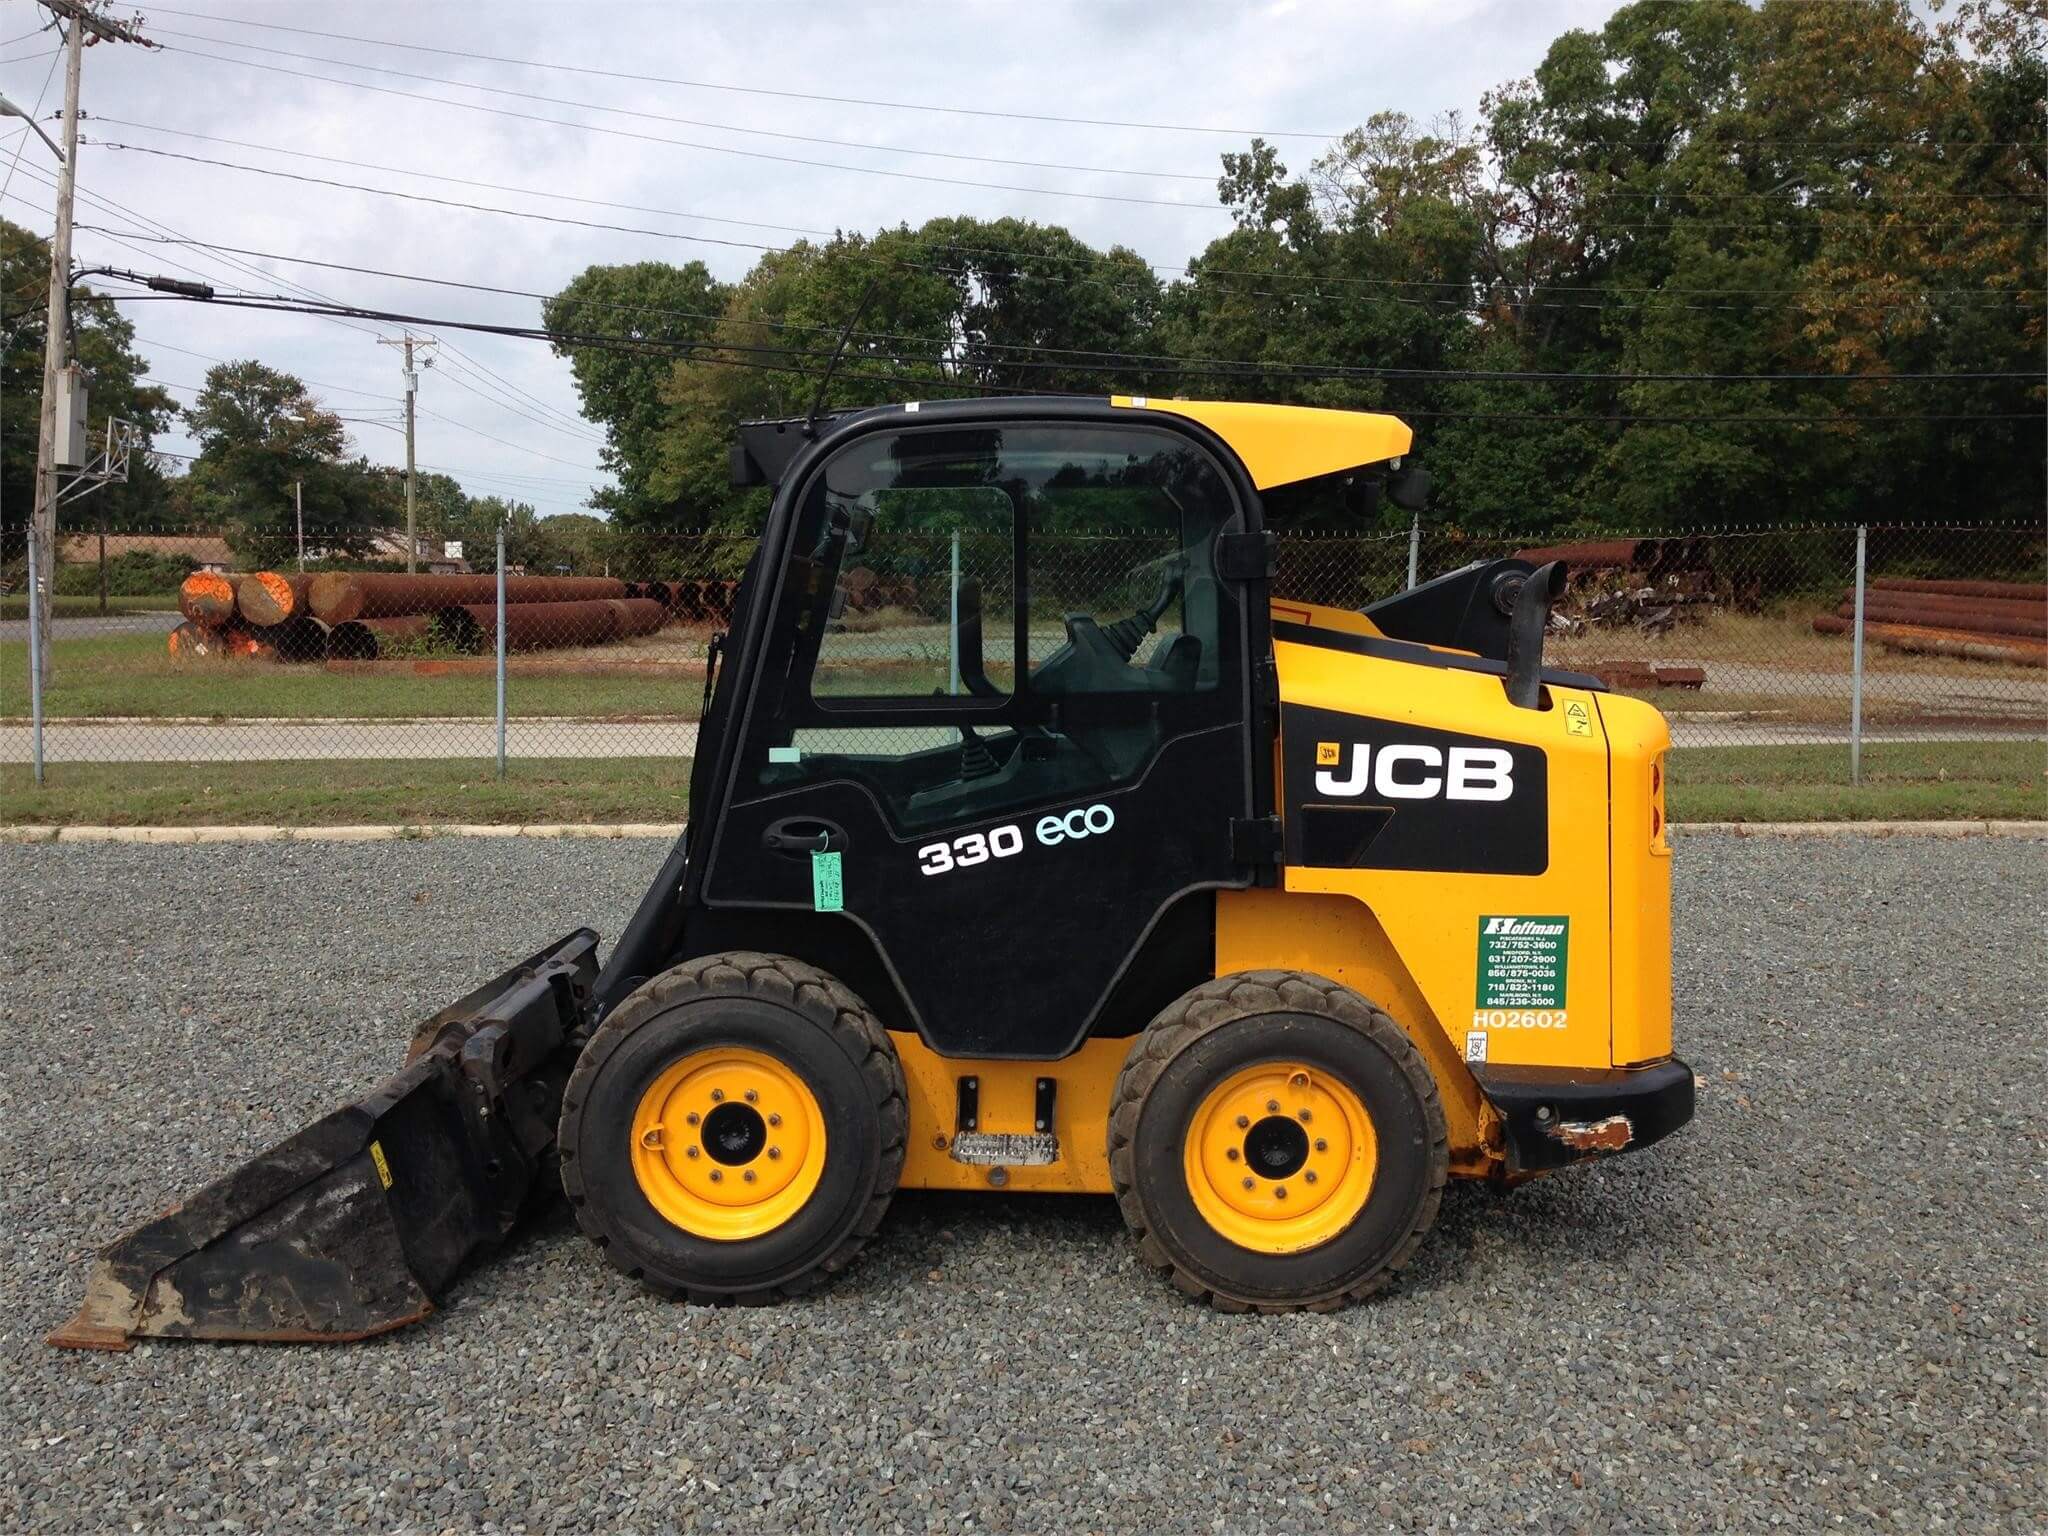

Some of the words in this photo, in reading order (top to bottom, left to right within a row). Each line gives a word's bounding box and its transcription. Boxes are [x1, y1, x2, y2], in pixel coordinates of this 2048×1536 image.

[1315, 743, 1514, 801] JCB
[918, 824, 1024, 876] 330
[1035, 804, 1115, 846] eco
[1483, 917, 1565, 935] Hoffman
[1489, 941, 1557, 949] 732/752-3600
[1488, 955, 1557, 963] 631/207-2900
